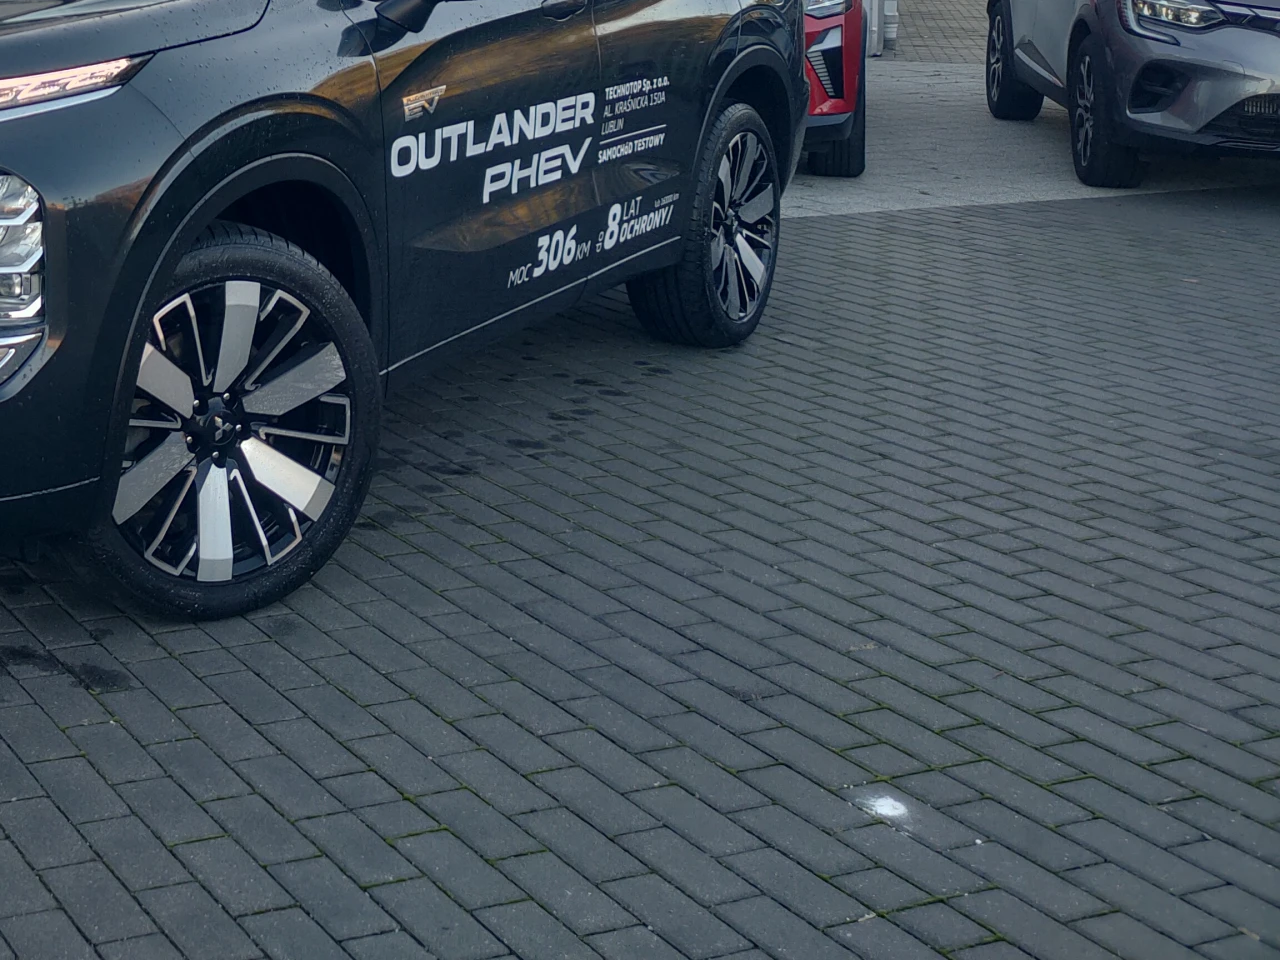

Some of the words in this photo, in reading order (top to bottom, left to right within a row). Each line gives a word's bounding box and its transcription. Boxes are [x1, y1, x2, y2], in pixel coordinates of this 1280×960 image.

[604, 79, 642, 101] TECHNOTOP
[614, 95, 649, 116] KRAŚNICKA
[390, 92, 596, 178] OUTLANDER
[601, 117, 625, 136] LUBLIN
[633, 132, 666, 153] TESTOWY
[482, 136, 593, 204] PHEV
[604, 203, 622, 250] 8
[622, 195, 643, 220] LAT
[507, 262, 533, 289] MOC
[532, 224, 578, 278] 306
[575, 240, 592, 262] KM
